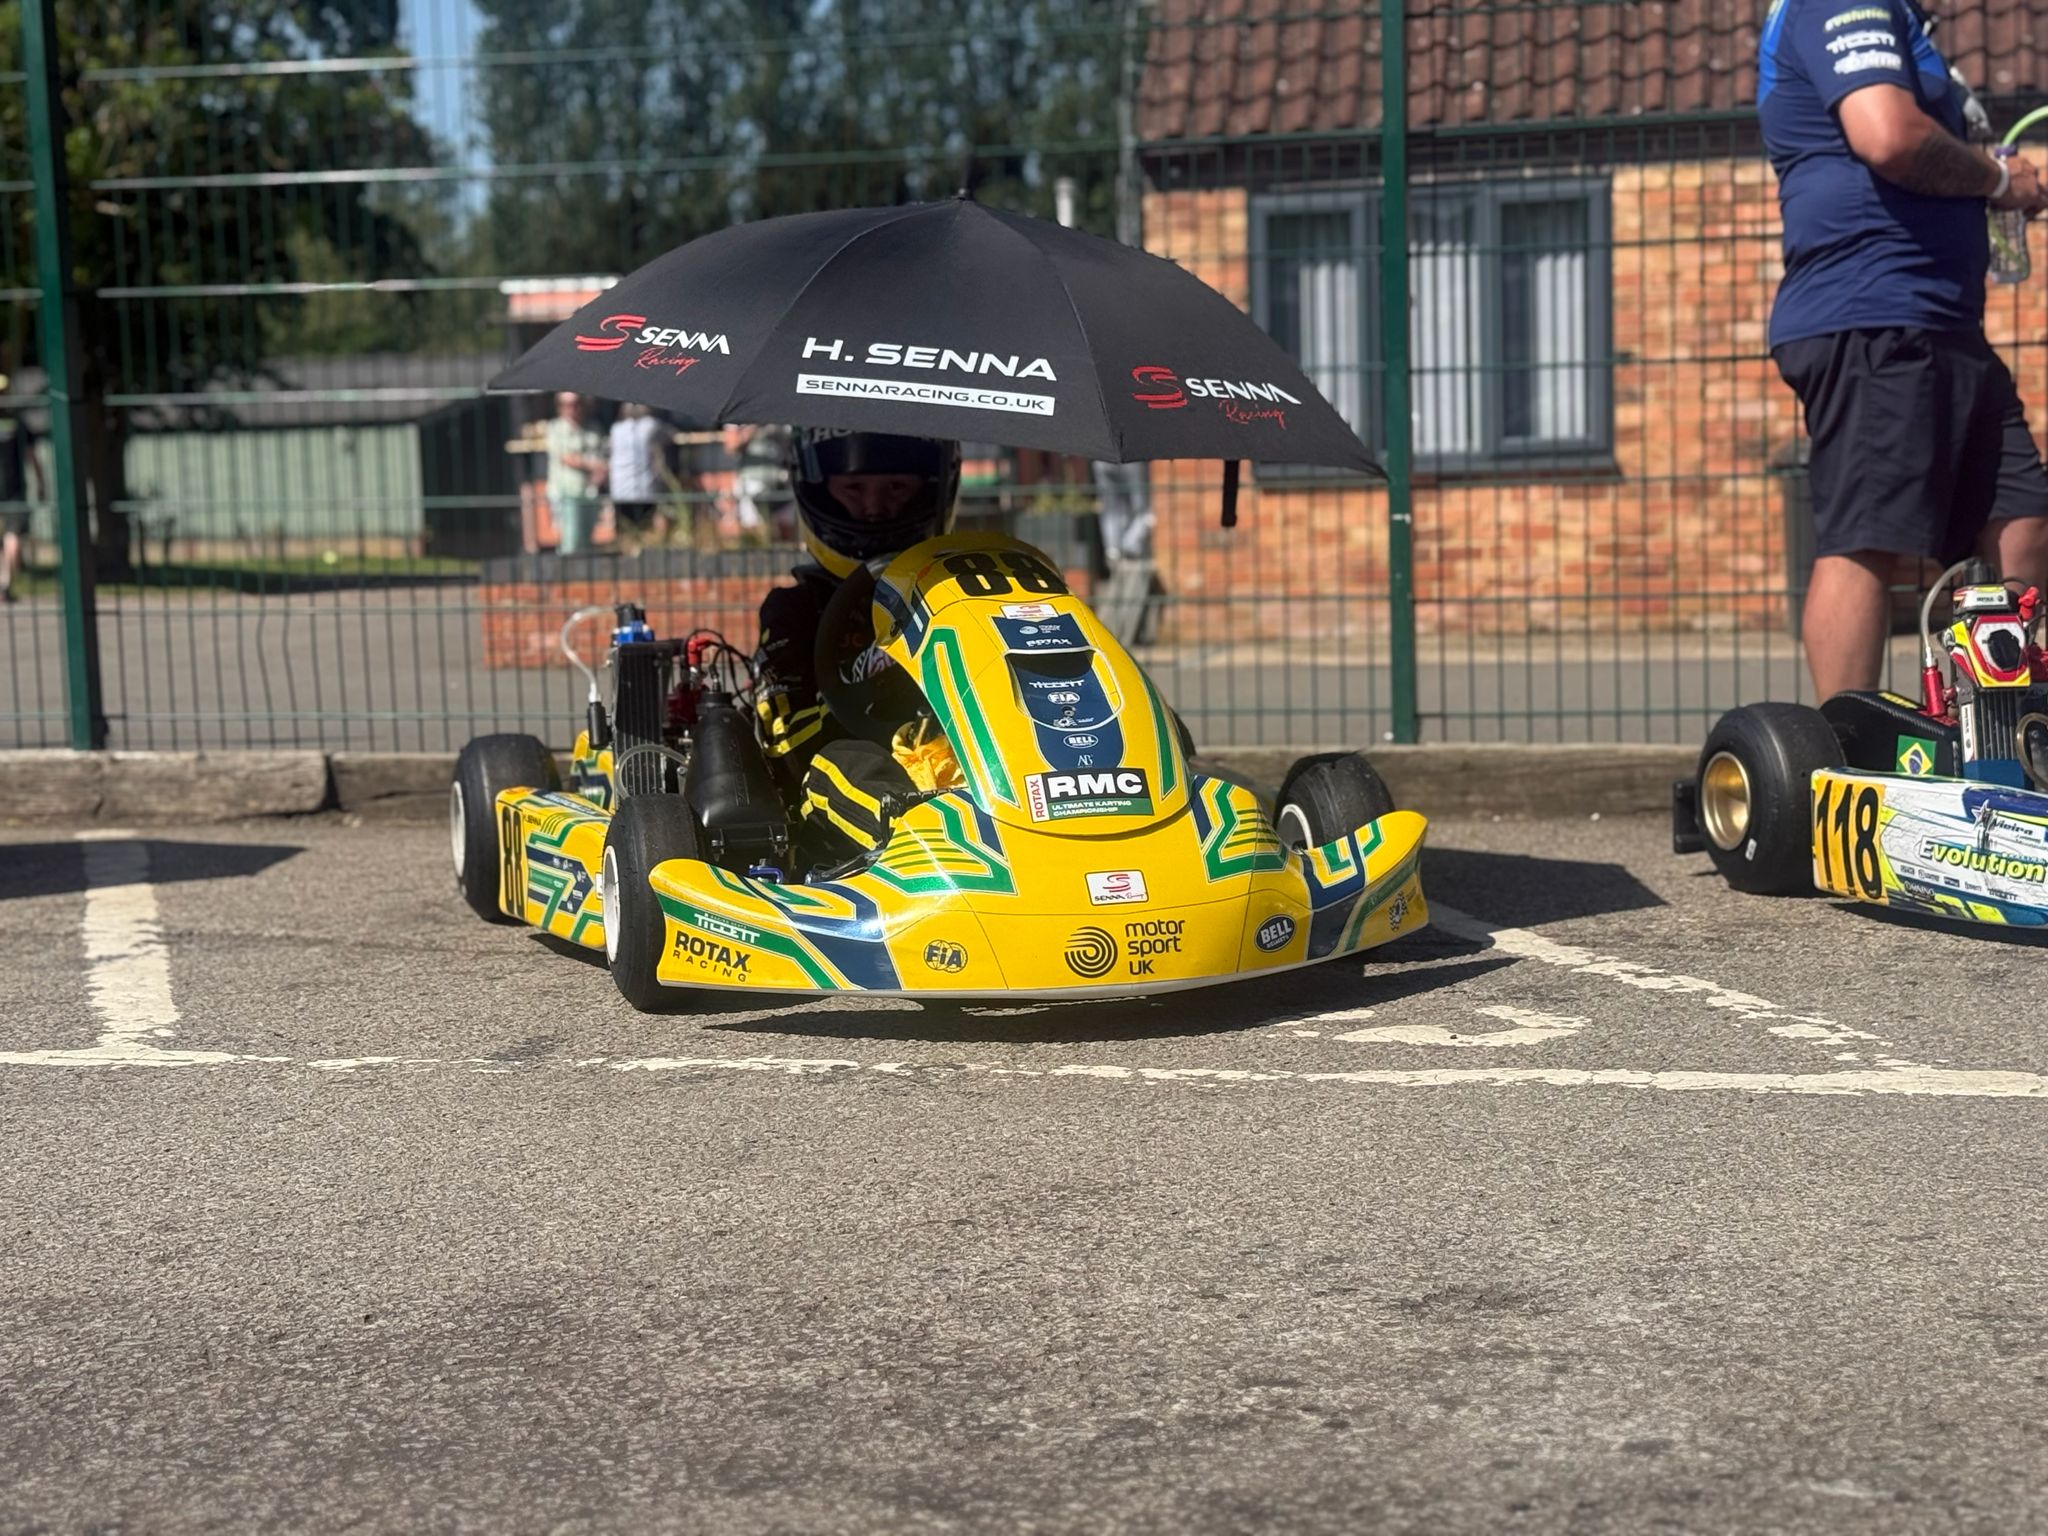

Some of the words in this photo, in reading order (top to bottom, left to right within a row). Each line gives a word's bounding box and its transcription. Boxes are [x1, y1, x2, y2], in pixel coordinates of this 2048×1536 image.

[634, 326, 731, 355] SENNA
[633, 347, 701, 376] Racing
[802, 337, 854, 361] H.
[865, 343, 1057, 381] SENNA
[805, 379, 1046, 411] SENNARACING.CO.UK
[1185, 377, 1302, 405] SENNA
[1218, 399, 1287, 431] Racing
[943, 552, 1070, 597] 88
[1050, 693, 1078, 702] FIA
[1068, 736, 1095, 744] BELL
[1029, 778, 1045, 818] ROTAX
[1047, 772, 1143, 798] RMC
[1051, 801, 1094, 811] ULTIMATE
[1053, 807, 1119, 817] CHAMPIONSHIP
[1816, 779, 1883, 900] 118
[1919, 836, 2046, 884] Evolution
[1094, 894, 1126, 902] SENNA
[694, 912, 760, 944] TILLETT
[1125, 918, 1186, 938] motor
[1260, 919, 1292, 945] BELL
[1266, 934, 1289, 949] HELMETS
[675, 930, 750, 973] ROTAX
[1127, 936, 1182, 957] sport
[672, 949, 747, 982] RACING
[1129, 959, 1155, 975] UK
